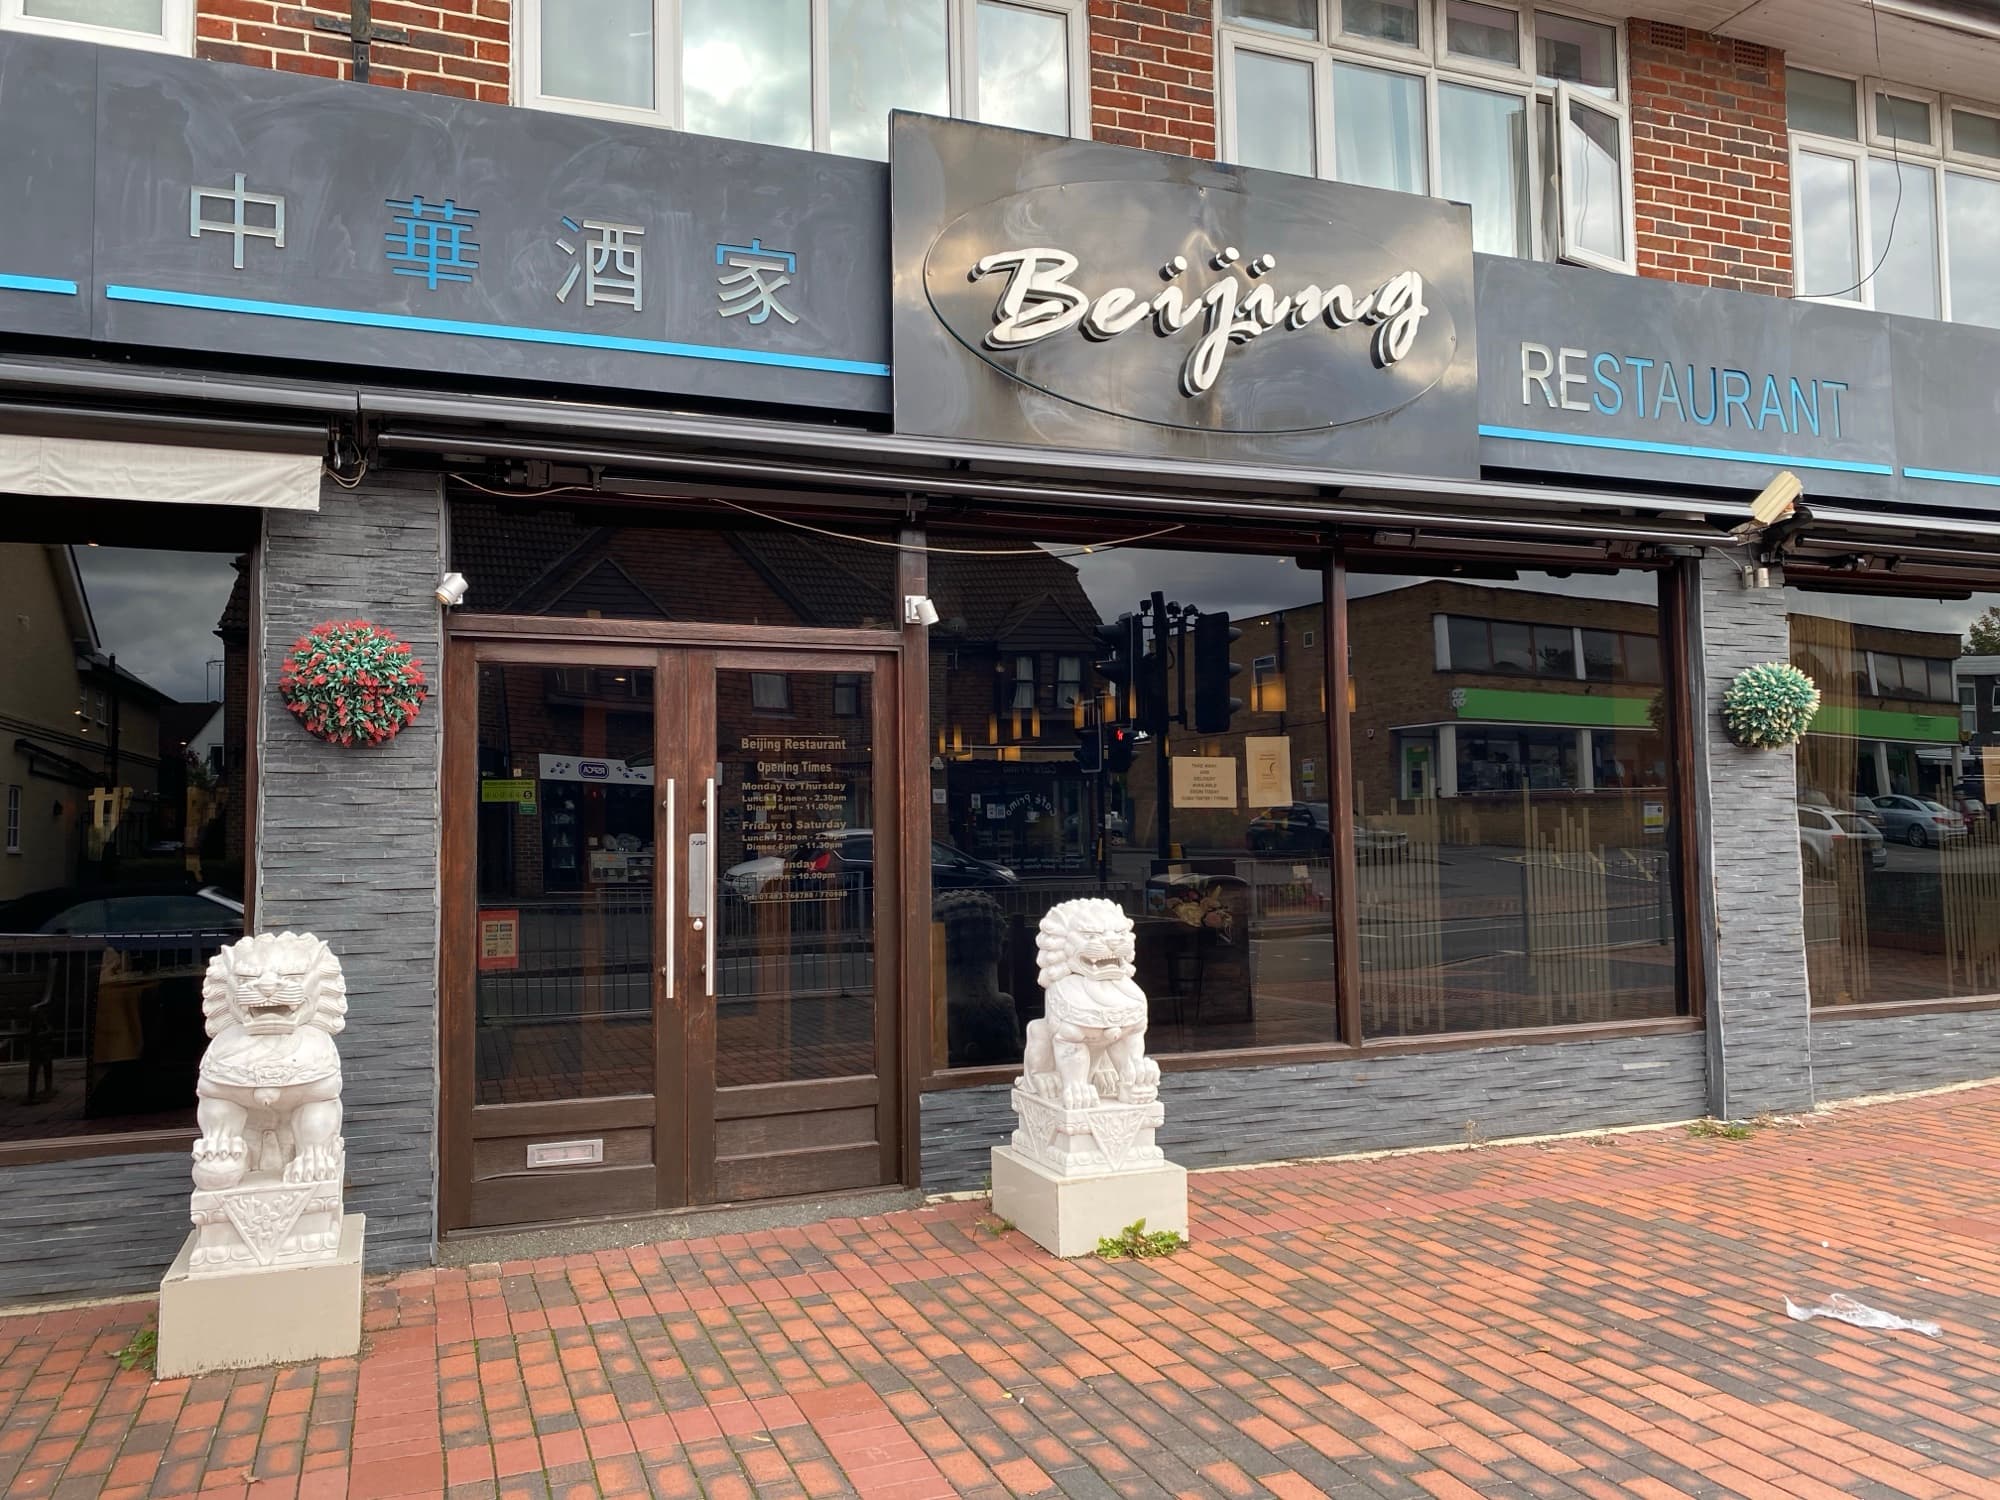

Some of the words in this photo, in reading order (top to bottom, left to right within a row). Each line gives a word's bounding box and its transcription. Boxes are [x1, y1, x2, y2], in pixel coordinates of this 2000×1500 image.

[190, 173, 798, 325] 中華酒家
[967, 247, 1429, 398] Beijing
[1520, 341, 1849, 438] RESTAURANT
[741, 738, 781, 752] Beijing
[785, 738, 847, 750] Restaurant
[757, 761, 799, 775] Opening
[801, 761, 832, 773] Times
[741, 782, 783, 793] Monday
[785, 783, 796, 791] to
[800, 782, 846, 792] Thursday
[815, 795, 847, 803] 2.30pm
[778, 804, 798, 812] 6pm
[806, 803, 842, 811] 11.00pm
[742, 821, 777, 831] Friday
[796, 821, 847, 831] Saturday
[778, 843, 798, 851] 6pm
[806, 842, 843, 850] 11.30pm
[775, 860, 817, 870] Sunday
[799, 872, 836, 881] 10.00pm
